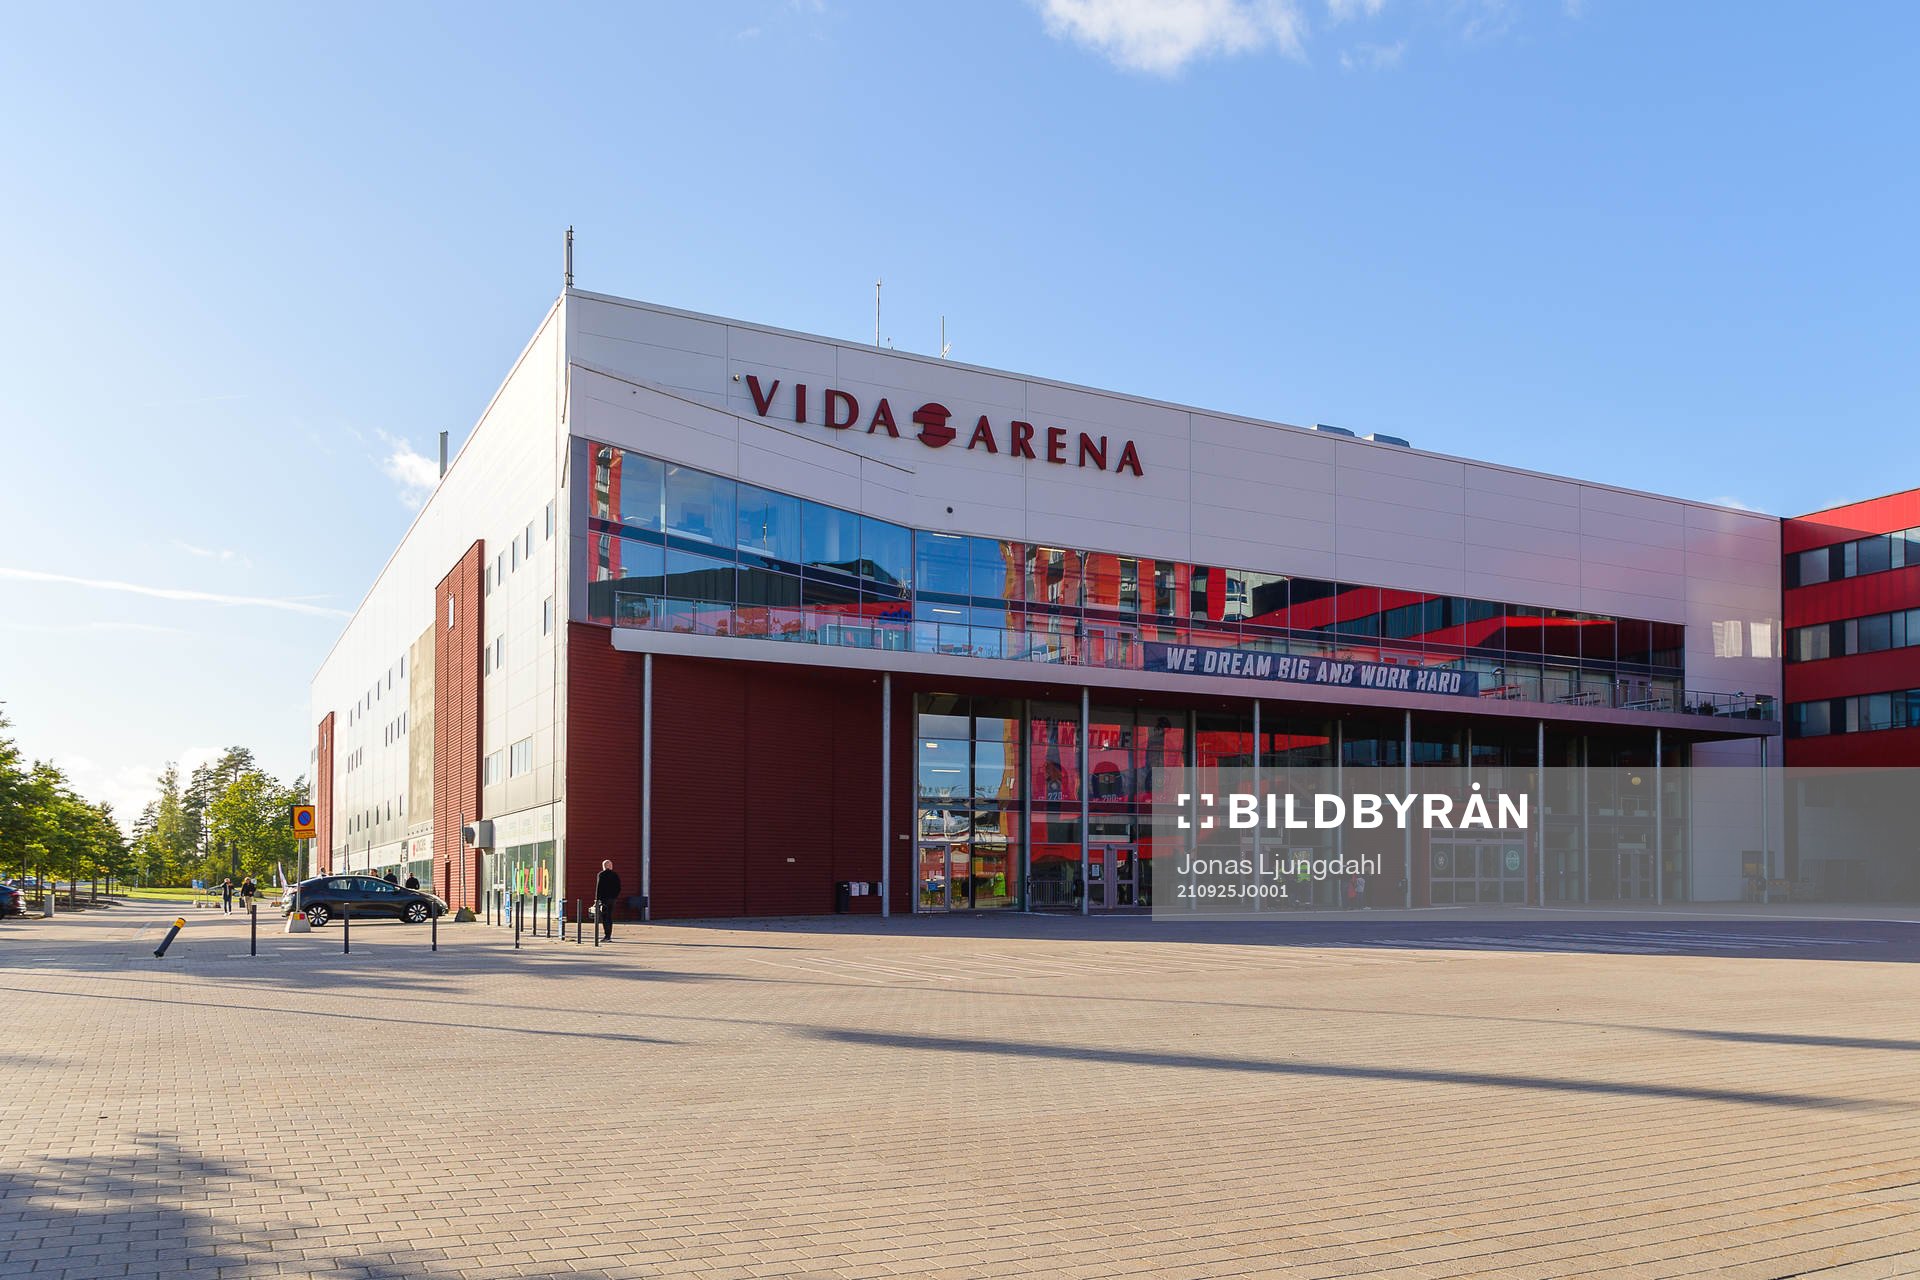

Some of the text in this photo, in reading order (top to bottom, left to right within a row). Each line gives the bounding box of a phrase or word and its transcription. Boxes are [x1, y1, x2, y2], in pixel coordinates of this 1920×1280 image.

[745, 374, 1144, 477] VIDA ARENA
[1166, 647, 1462, 694] WE DREAM BIG AND WORK HARD
[511, 859, 550, 897] kidzclub
